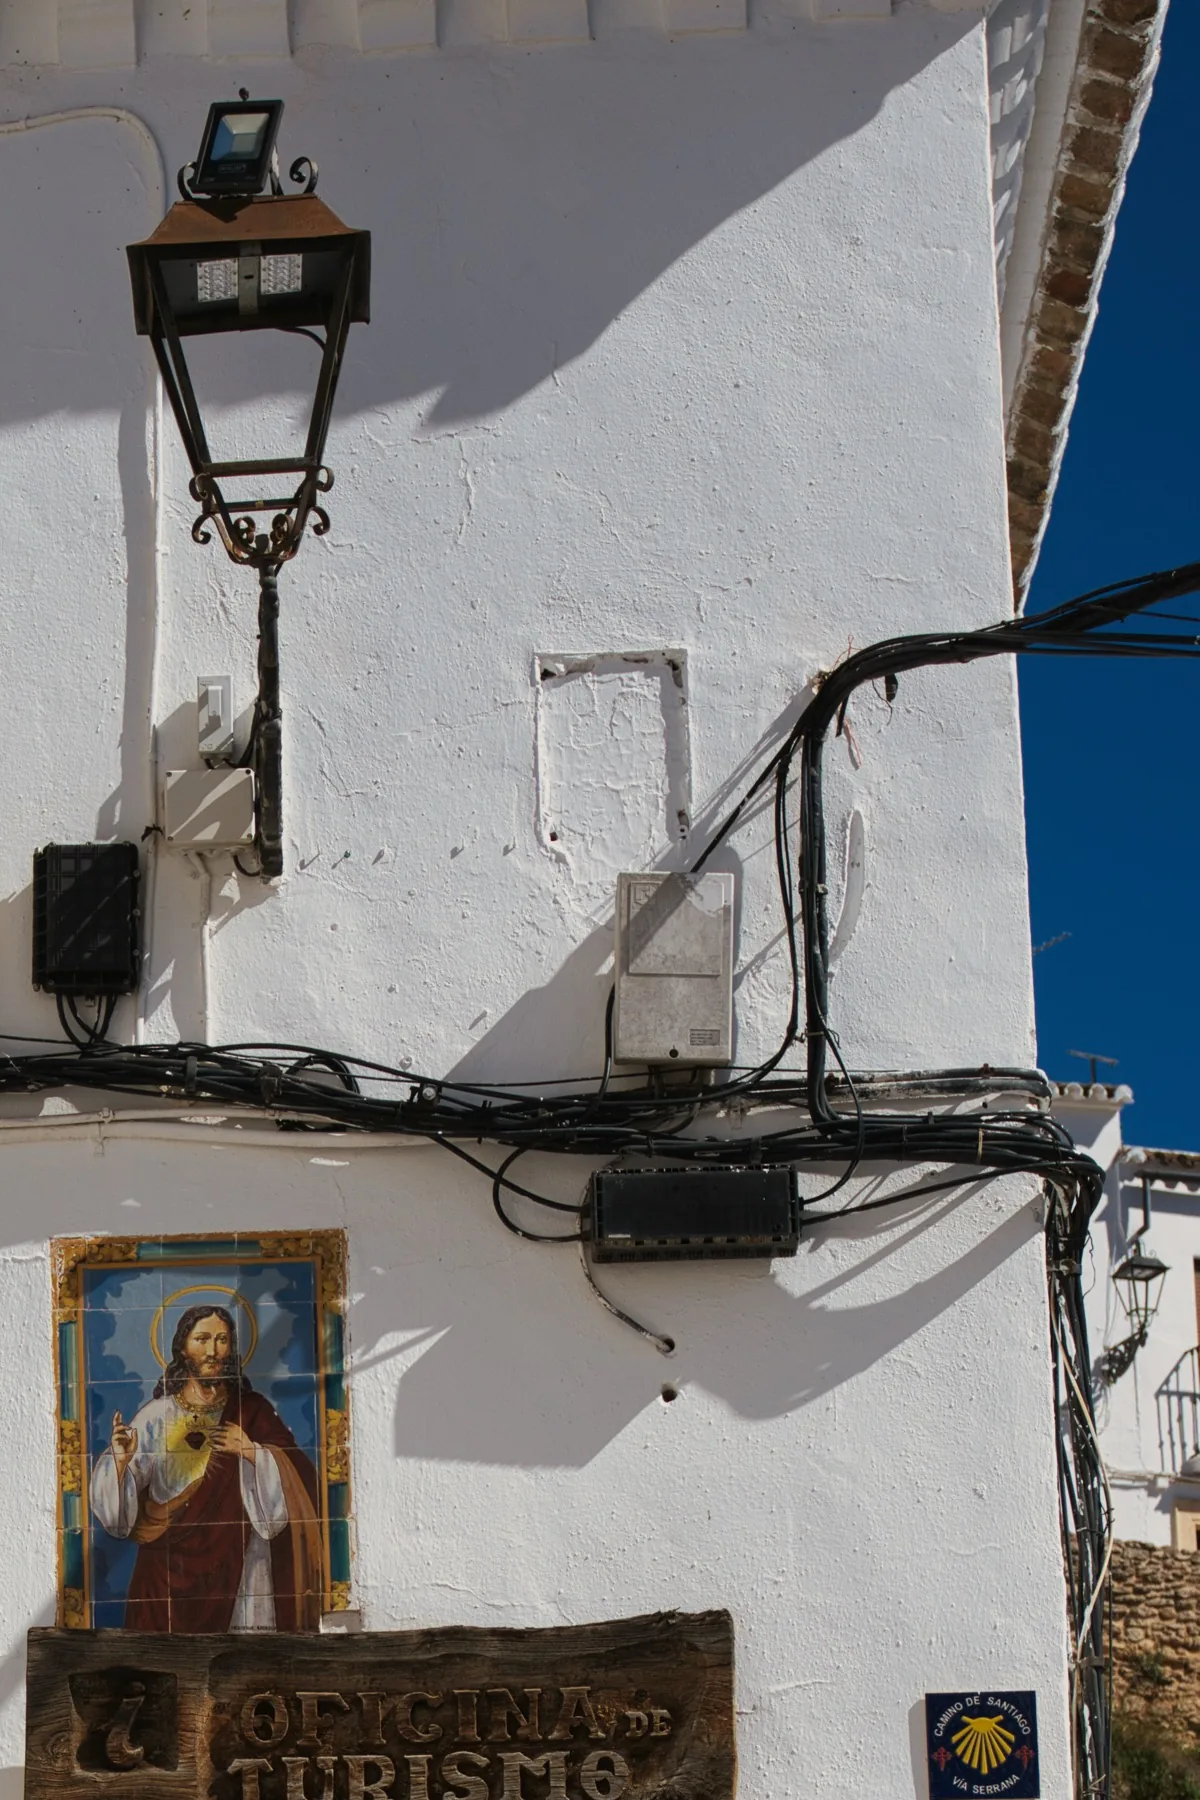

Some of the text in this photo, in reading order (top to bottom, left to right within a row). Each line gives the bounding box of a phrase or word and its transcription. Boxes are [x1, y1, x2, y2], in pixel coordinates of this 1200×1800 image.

[240, 1687, 673, 1747] OFICINA DE
[934, 1696, 1031, 1737] CAMINO DE SANTIAGO
[972, 1774, 1020, 1794] SERRANA
